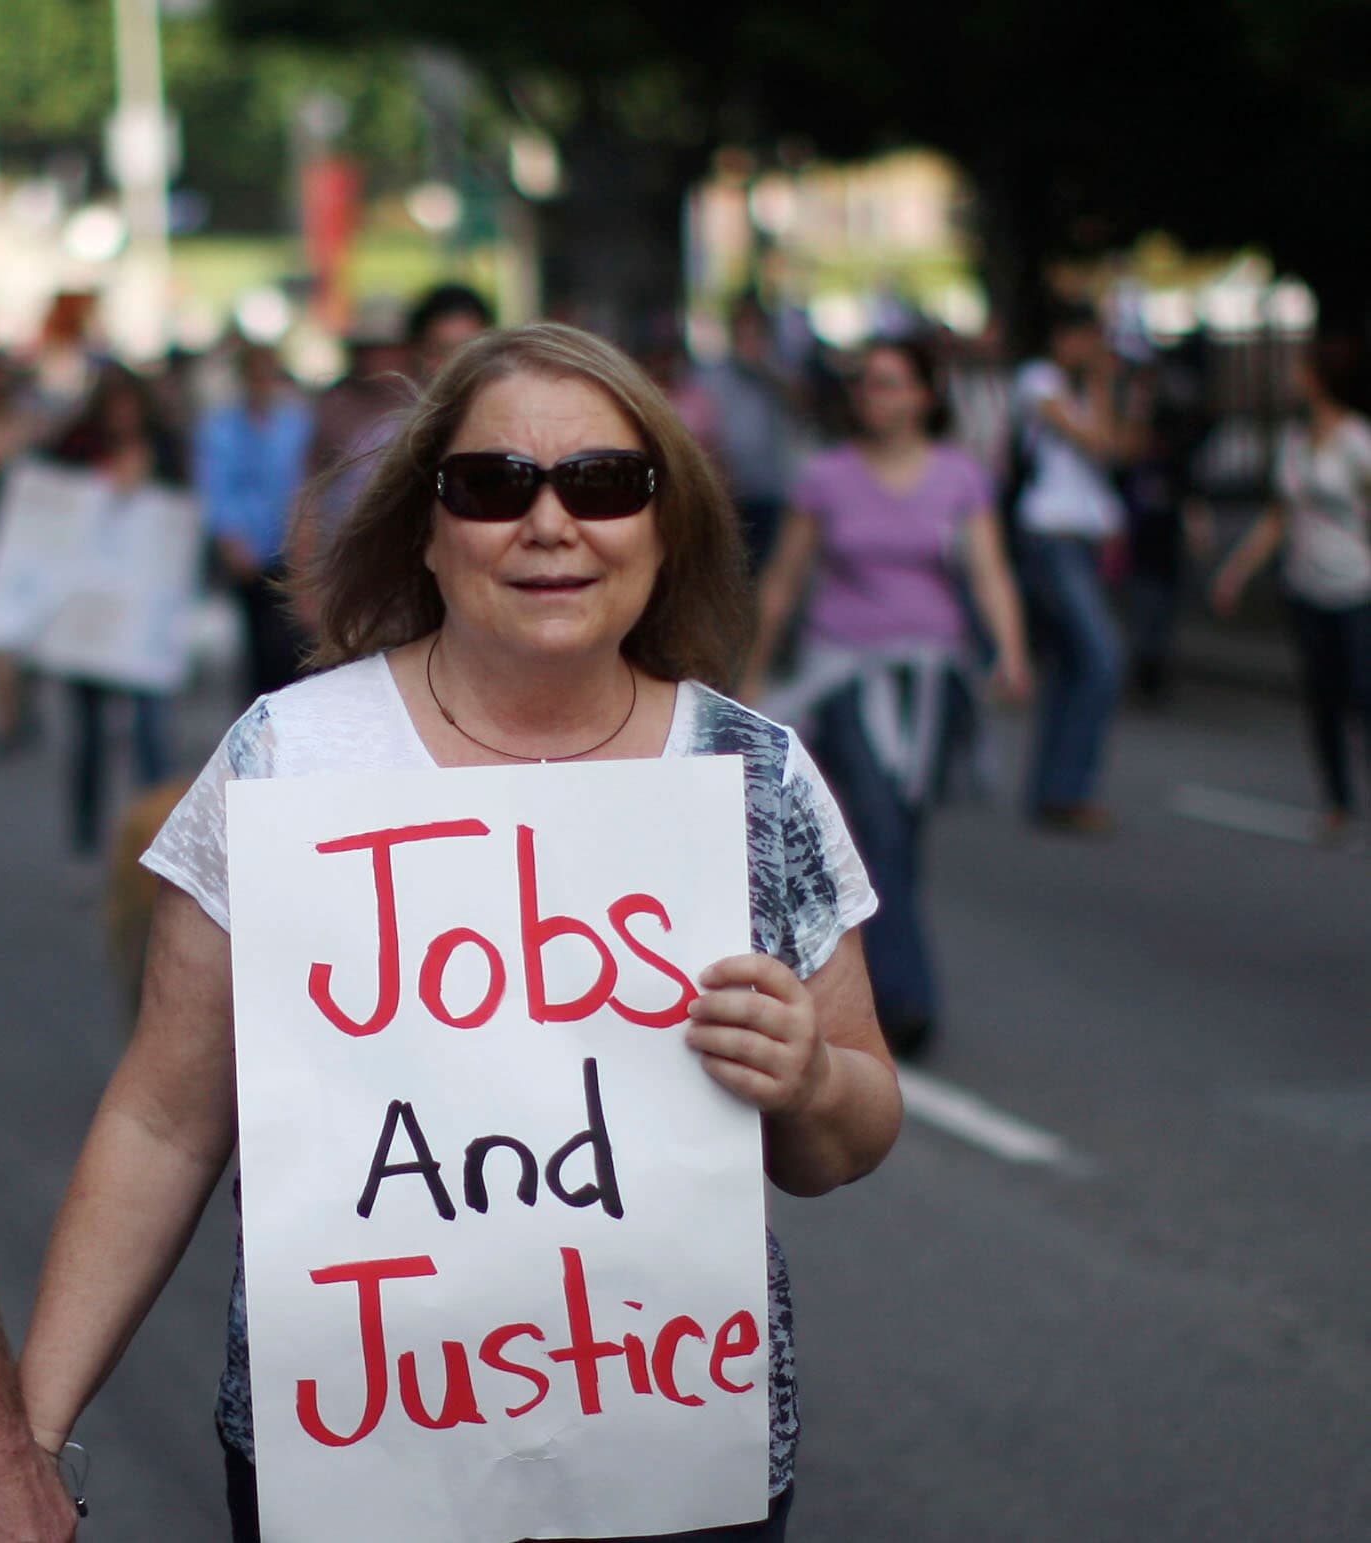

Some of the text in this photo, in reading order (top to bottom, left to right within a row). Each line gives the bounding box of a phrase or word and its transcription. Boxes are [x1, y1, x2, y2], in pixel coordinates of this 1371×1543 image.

[308, 818, 699, 1037] Jobs
[356, 1056, 625, 1222] And
[295, 1246, 760, 1448] Justice
